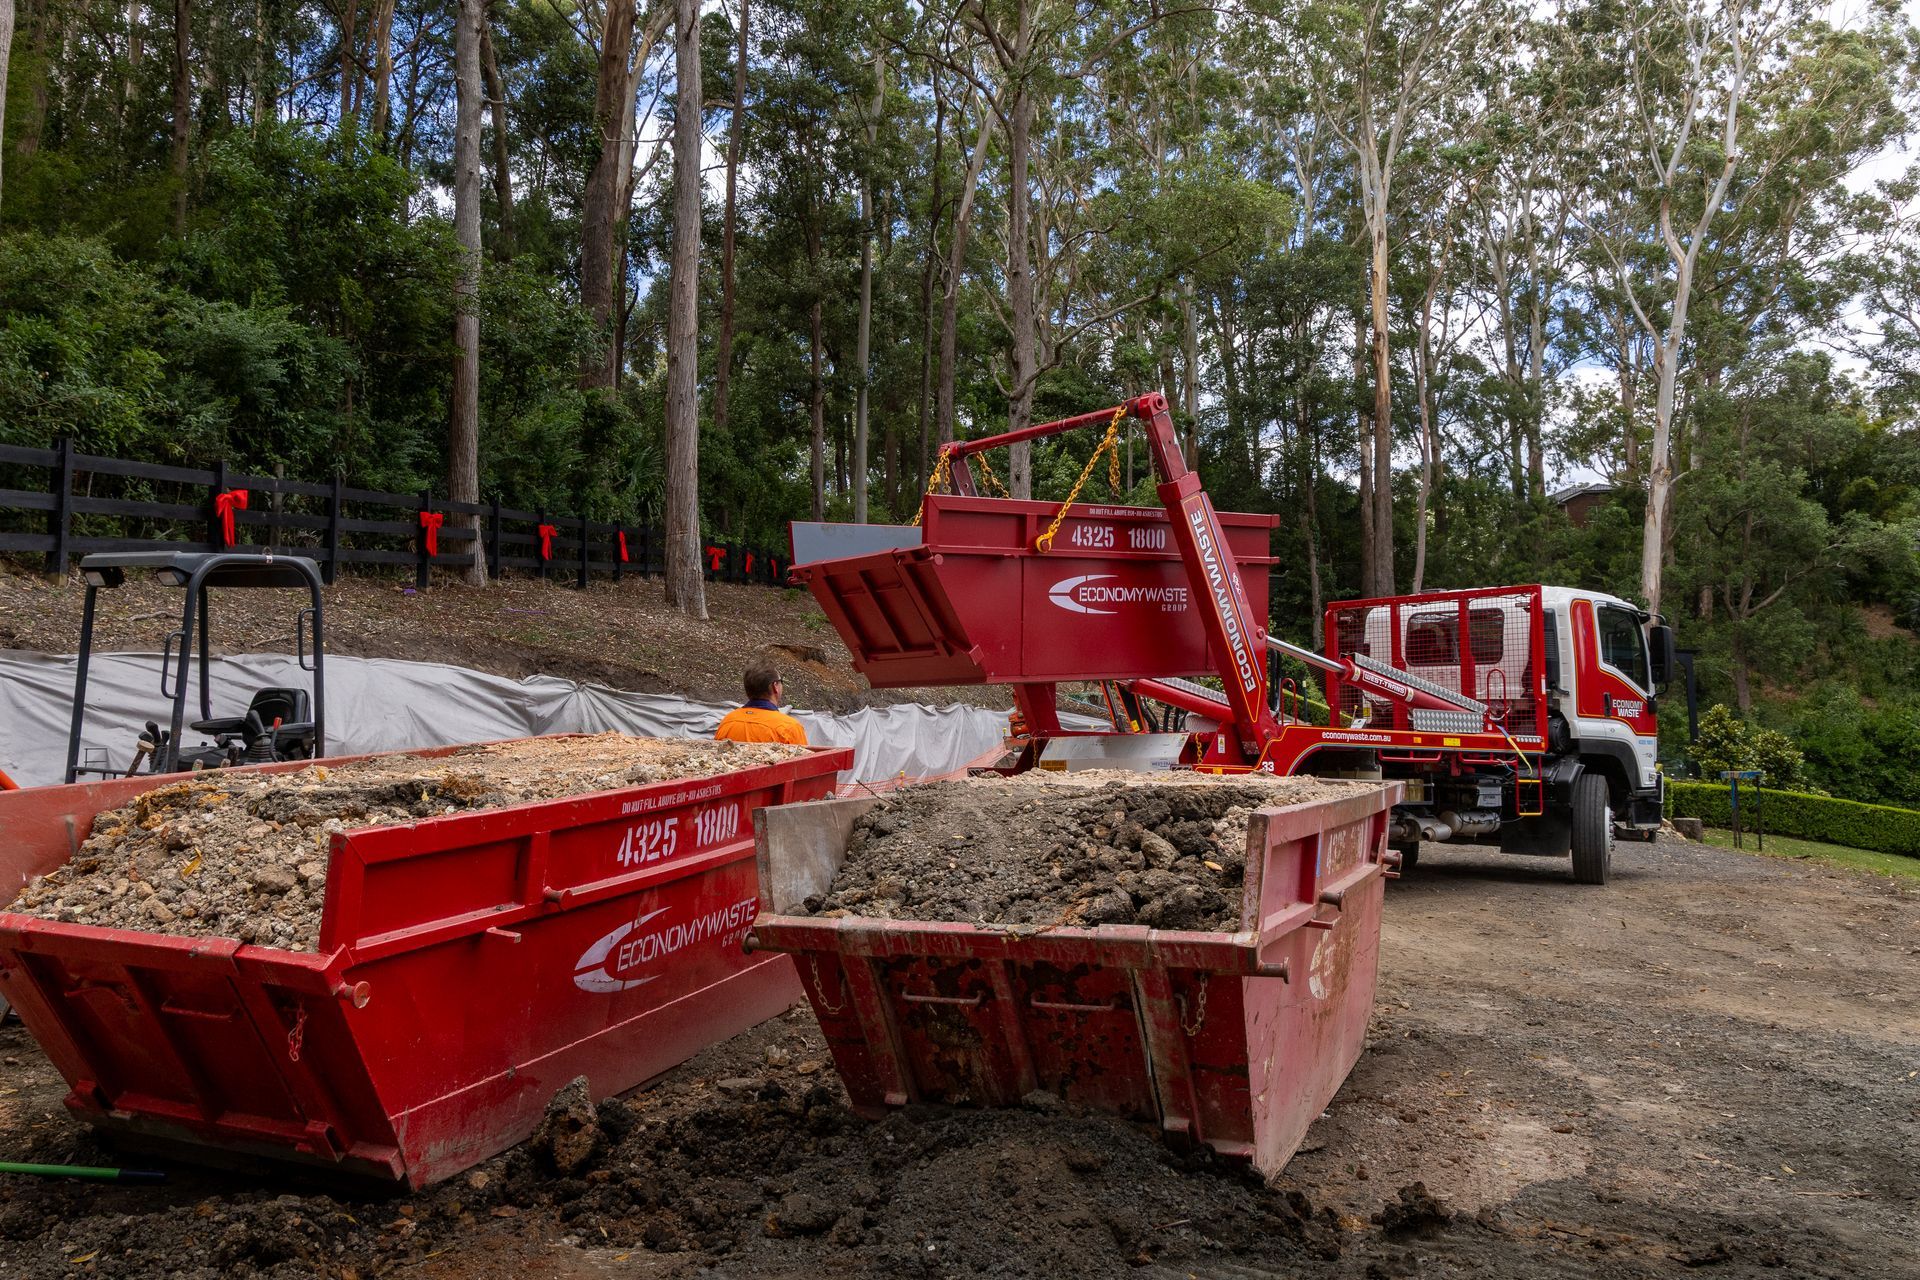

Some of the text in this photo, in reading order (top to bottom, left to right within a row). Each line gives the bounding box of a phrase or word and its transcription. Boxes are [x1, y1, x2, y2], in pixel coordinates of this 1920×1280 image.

[1071, 525, 1166, 549] 4325 1800
[1079, 587, 1187, 602] ECONOMYWASTE
[1191, 508, 1256, 692] ECONOMYWASTE
[1161, 604, 1187, 612] GROUP
[1364, 672, 1405, 694] WEST-TRANS
[1612, 699, 1644, 710] ECONOMY
[1617, 708, 1641, 718] WASTE
[1321, 731, 1392, 742] economywaste.com.au
[1261, 761, 1275, 772] 33
[617, 803, 739, 867] 4325 1800
[617, 896, 757, 972] ECONOMYWASTE
